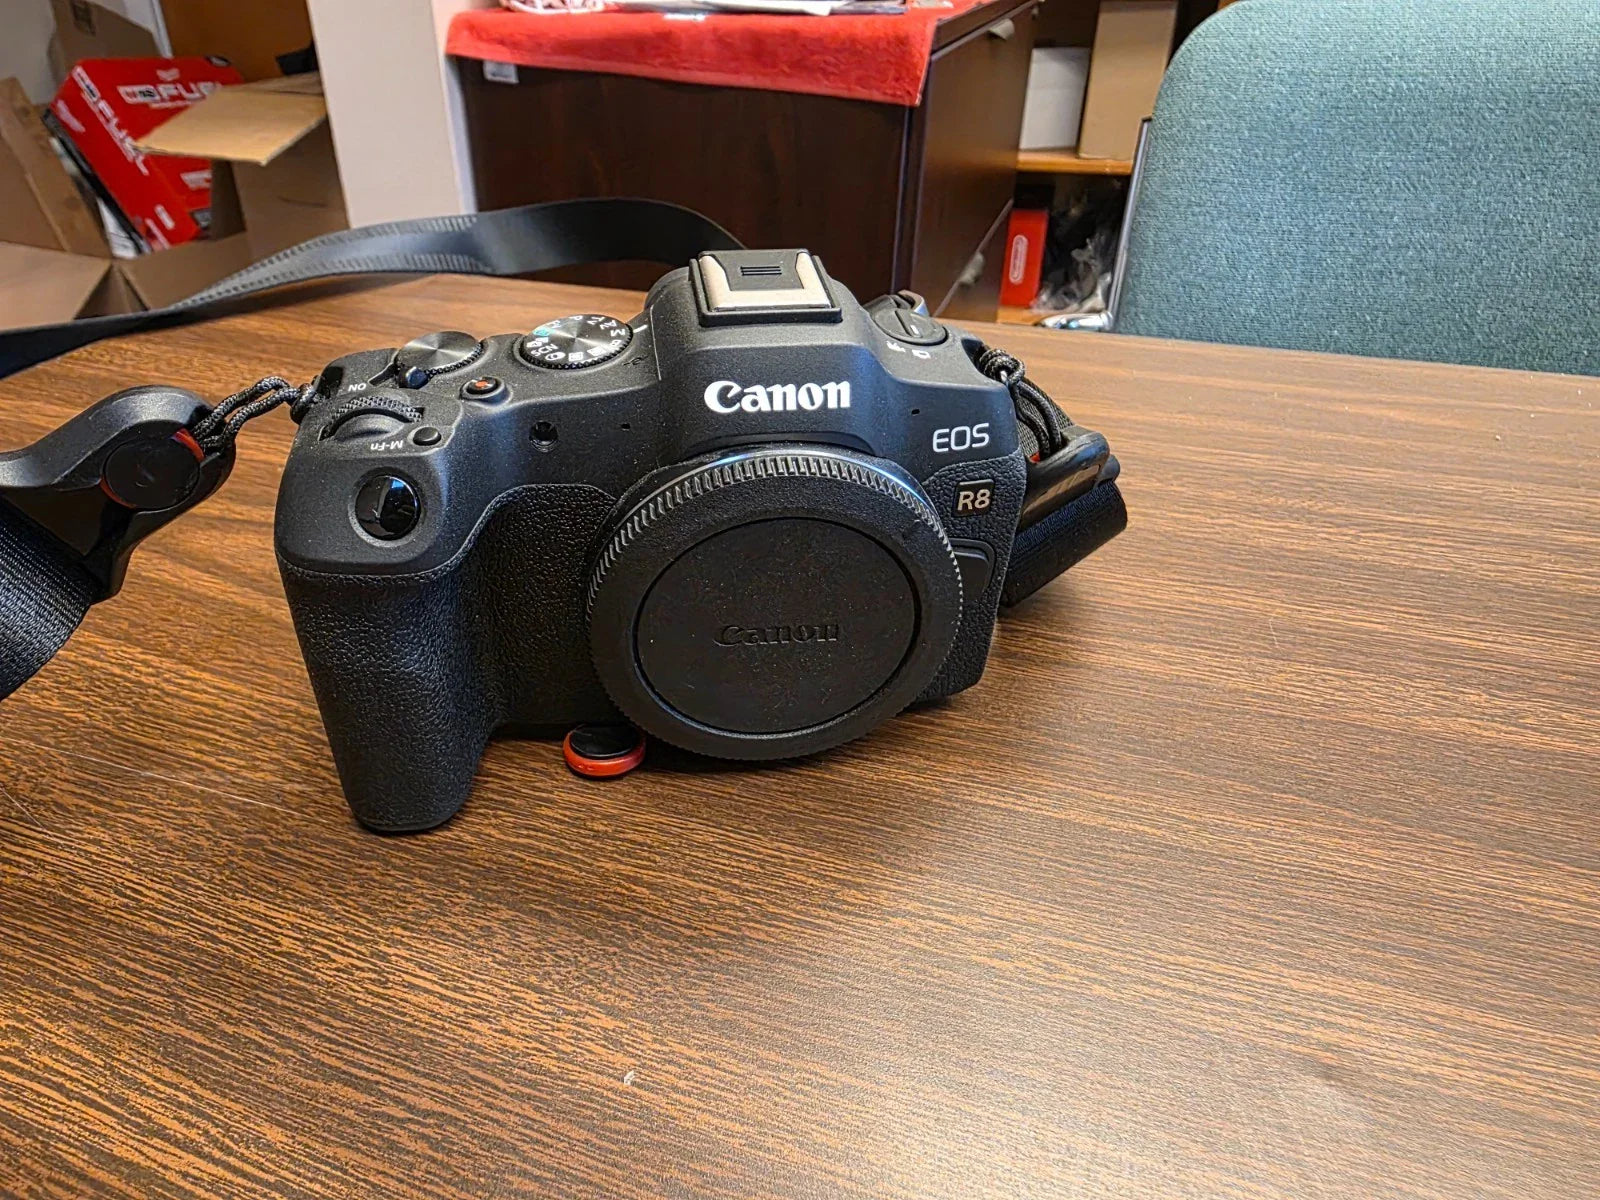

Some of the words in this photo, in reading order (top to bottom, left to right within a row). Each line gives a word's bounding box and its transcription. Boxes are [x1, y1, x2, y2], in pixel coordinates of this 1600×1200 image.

[610, 328, 626, 337] M
[347, 383, 367, 392] ON
[703, 380, 851, 413] Canon
[370, 440, 404, 451] M-Fn
[932, 422, 990, 453] EOS
[957, 489, 991, 512] R8
[712, 624, 839, 647] Canon
